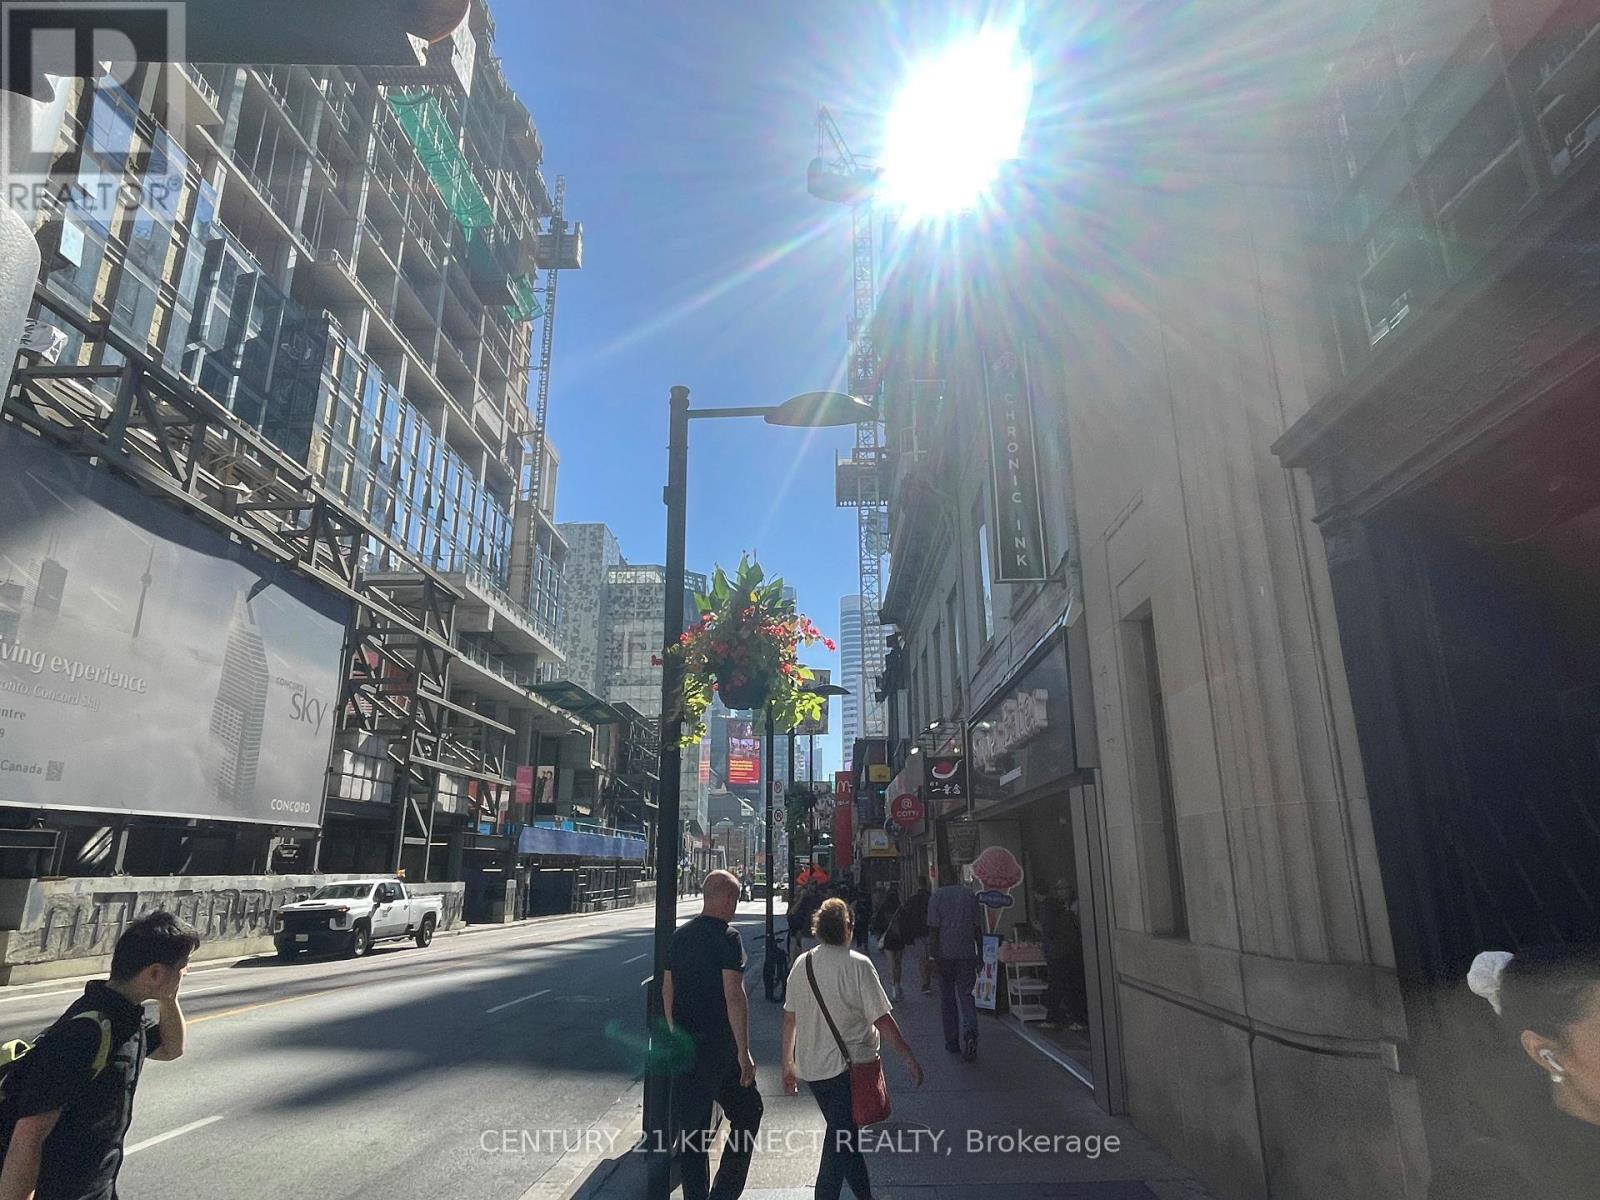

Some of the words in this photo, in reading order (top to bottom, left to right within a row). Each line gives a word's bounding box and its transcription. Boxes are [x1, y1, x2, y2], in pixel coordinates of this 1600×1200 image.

[1004, 393, 1022, 503] CHRONIC
[1014, 519, 1028, 567] INK
[50, 655, 148, 694] experience
[0, 706, 26, 721] ntre
[0, 759, 43, 775] Canada
[270, 798, 311, 813] CONCORD
